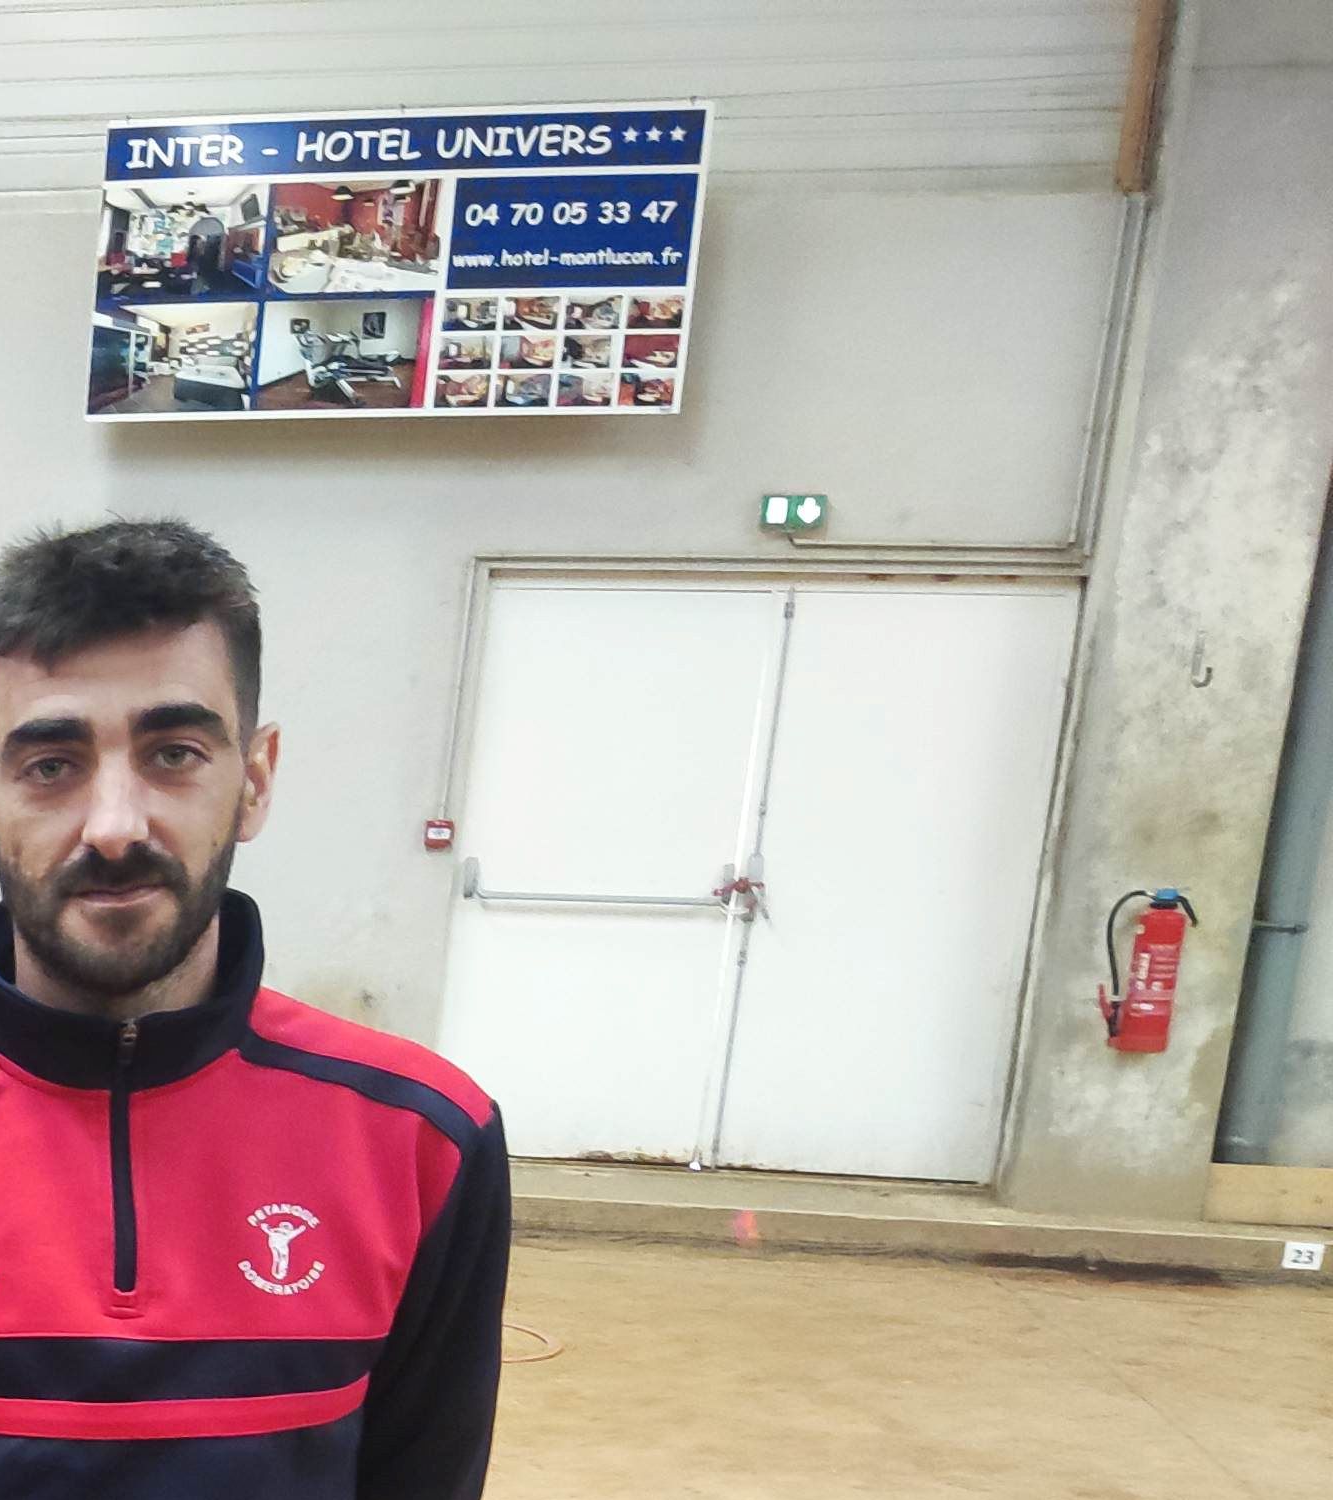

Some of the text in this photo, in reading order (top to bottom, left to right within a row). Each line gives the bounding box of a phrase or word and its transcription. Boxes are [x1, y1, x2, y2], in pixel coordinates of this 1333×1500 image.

[125, 136, 245, 169] INTER
[295, 127, 422, 163] HOTEL
[436, 124, 613, 159] UNIVERS
[465, 200, 678, 227] 04 70 05 33 47
[452, 247, 683, 268] www.hotel-montlucon.fr
[1291, 1249, 1314, 1264] 23
